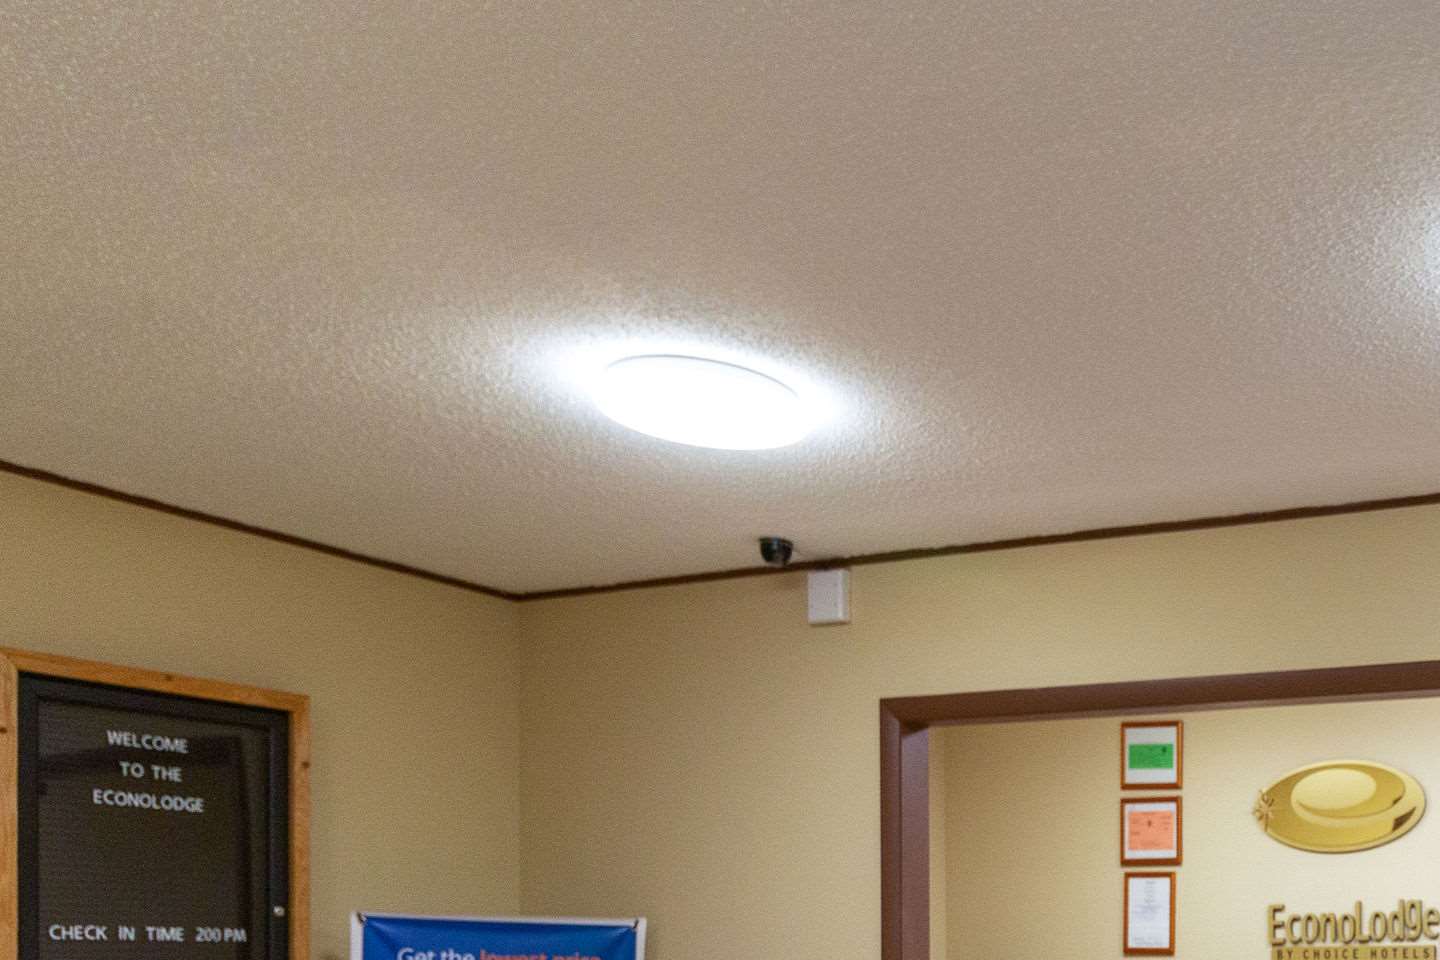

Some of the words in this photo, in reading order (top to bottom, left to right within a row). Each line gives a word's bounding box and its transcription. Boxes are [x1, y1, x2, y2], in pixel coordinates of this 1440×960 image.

[106, 729, 189, 754] WELCOME
[119, 761, 145, 778] TO
[152, 765, 182, 783] THE
[92, 788, 205, 813] ECONOLODGE
[49, 924, 108, 941] CHECK
[118, 925, 136, 941] IN
[145, 926, 185, 942] TIME
[223, 927, 248, 943] PM
[1277, 948, 1294, 960] BY
[1303, 948, 1359, 960] CHOICE
[1370, 948, 1431, 960] HOTELS
